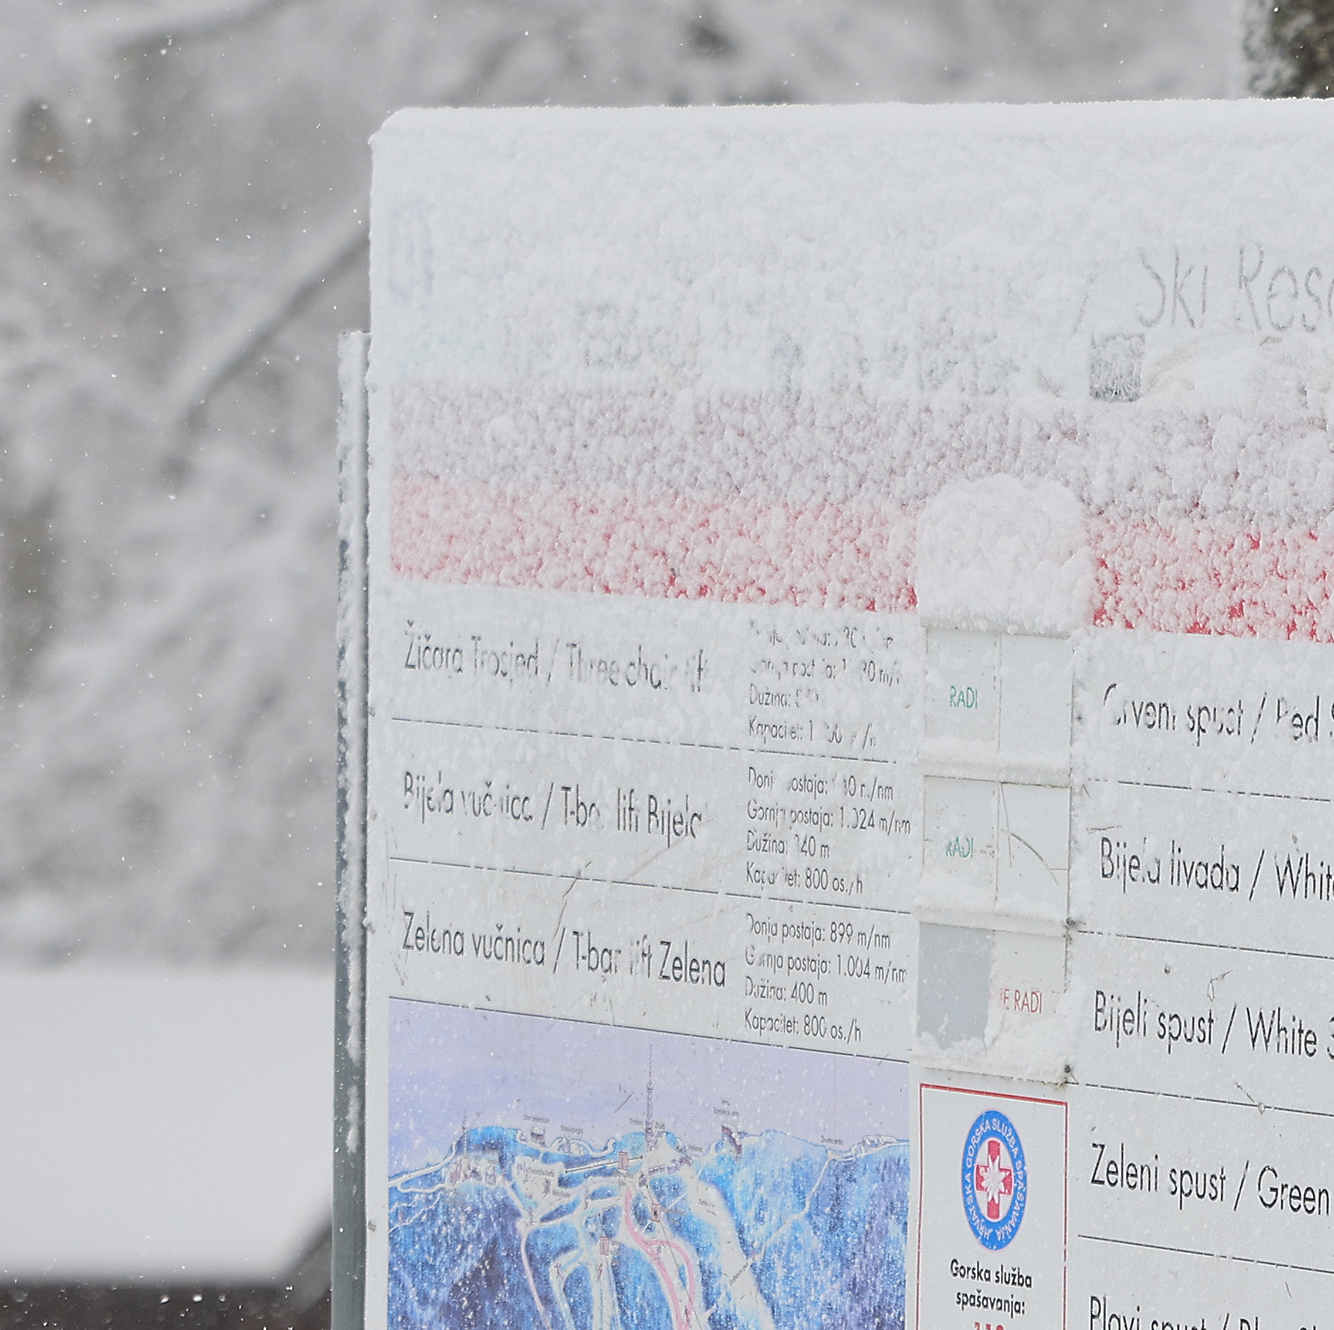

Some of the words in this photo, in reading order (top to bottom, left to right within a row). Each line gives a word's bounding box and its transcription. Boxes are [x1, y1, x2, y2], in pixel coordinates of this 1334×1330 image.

[1136, 244, 1208, 329] Ski
[404, 620, 464, 675] Žičara
[949, 685, 978, 709] RADI
[804, 867, 829, 891] 800
[1169, 839, 1240, 893] livada
[403, 910, 465, 957] Zelena
[471, 923, 546, 967] vučnica
[659, 940, 727, 988] Zelena
[781, 918, 827, 948] postaja:
[830, 922, 854, 945] 899
[857, 925, 891, 950] m/nm
[788, 950, 832, 979] postaja:
[836, 954, 871, 978] 1.004
[790, 981, 815, 1005] 400
[1014, 988, 1044, 1015] RADI
[745, 1007, 800, 1036] Kapacitet:
[803, 1014, 828, 1038] 800
[831, 1018, 862, 1044] os./h
[1093, 989, 1149, 1049] Bijeli
[1157, 1007, 1214, 1055] spust
[1245, 1006, 1318, 1058] White
[965, 1119, 991, 1169] GORSKA
[991, 1118, 1019, 1159] SLUŽBA
[1090, 1142, 1159, 1193] Zeleni
[1169, 1165, 1226, 1211] spust
[1257, 1164, 1331, 1217] Green
[950, 1258, 992, 1283] Gorska
[994, 1263, 1033, 1289] služba
[955, 1288, 1026, 1319] spašavanja:
